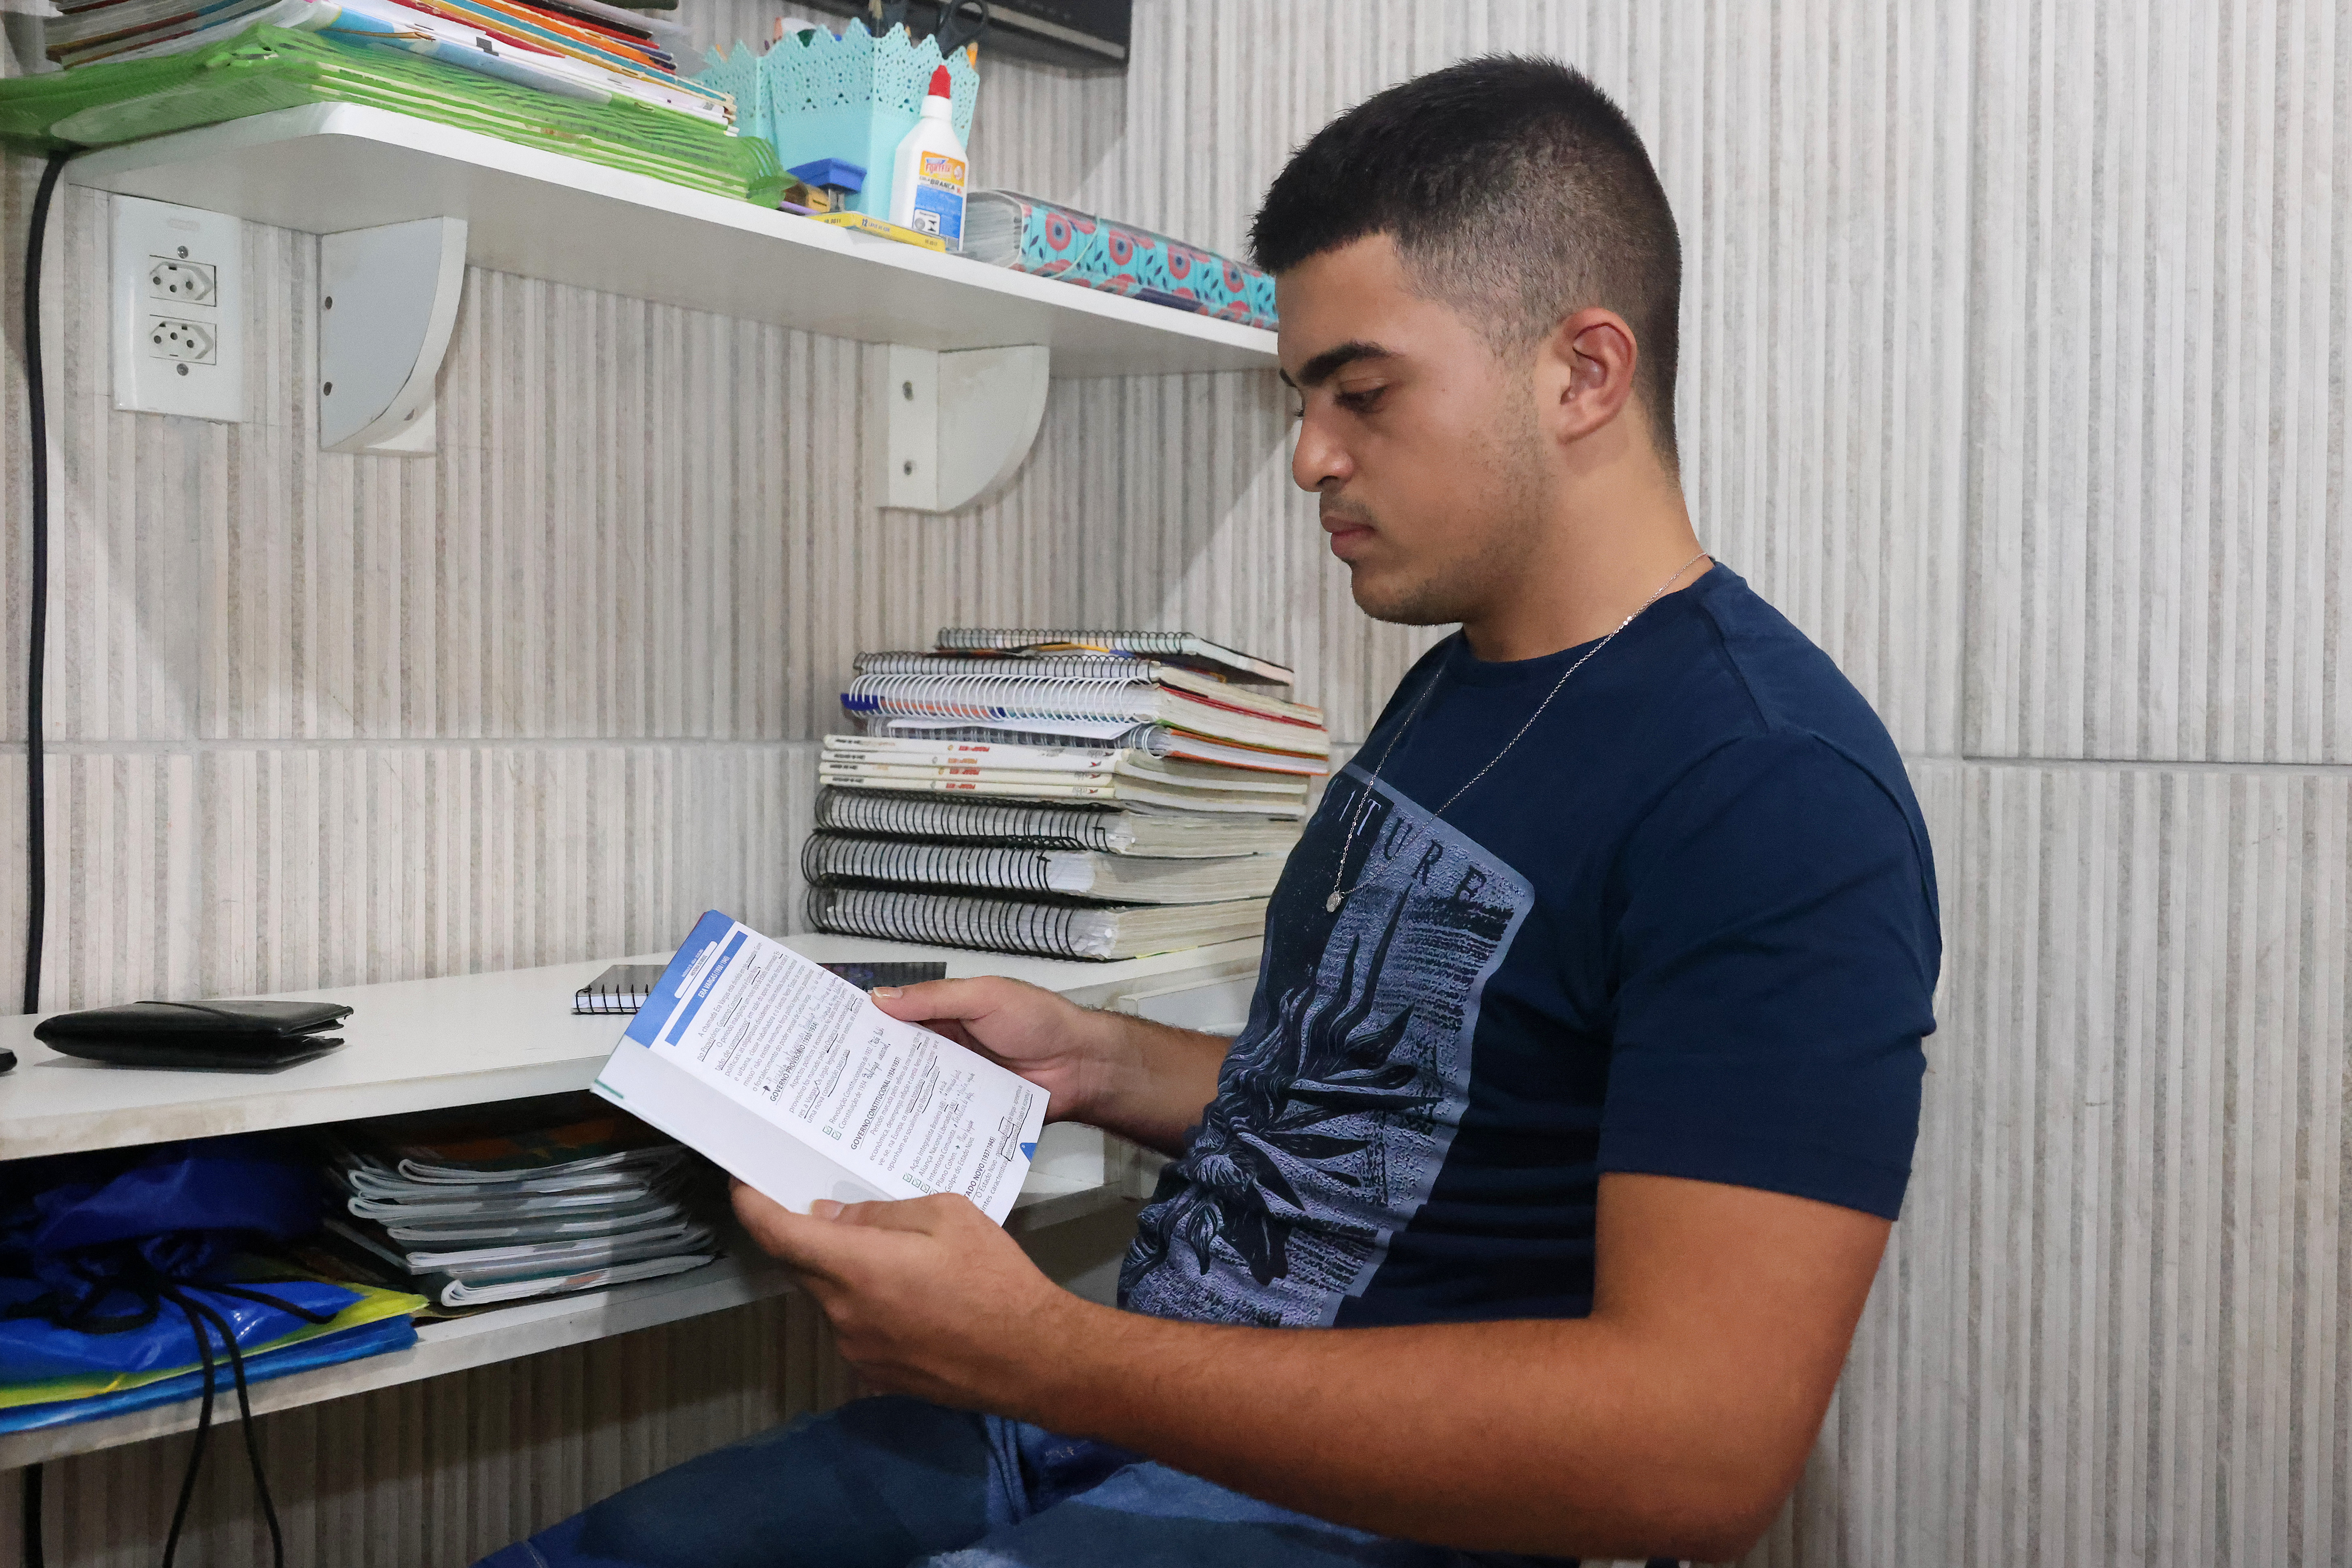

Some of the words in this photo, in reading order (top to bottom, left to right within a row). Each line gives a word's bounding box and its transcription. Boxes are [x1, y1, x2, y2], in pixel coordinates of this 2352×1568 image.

[698, 988, 708, 998] ERA
[703, 973, 717, 989] VARGAS
[713, 965, 723, 975] (1930
[720, 955, 730, 964] 1945)
[716, 1009, 731, 1027] Governo
[728, 984, 746, 1009] Constitucional
[744, 973, 754, 983] Estado
[748, 989, 756, 998] novo
[751, 981, 760, 990] tipo
[702, 1012, 717, 1032] chamada
[718, 991, 730, 1004] Vargas
[714, 1058, 725, 1071] tado
[751, 1001, 760, 1011] razão
[761, 987, 769, 997] apoio
[731, 1004, 746, 1025] inaugurou
[742, 1024, 758, 1047] oligarquias
[755, 1004, 771, 1025] dissidentes,
[768, 993, 777, 1004] classes
[737, 1057, 752, 1076] urbana,
[749, 1042, 760, 1055] classe
[757, 1016, 775, 1042] trabalhadora
[754, 1058, 762, 1069] não
[760, 1044, 771, 1058] existia
[768, 1024, 782, 1044] nenhuma
[778, 1014, 788, 1024] força
[754, 1051, 778, 1086] fortalecimento
[779, 1032, 788, 1046] poder
[786, 1018, 797, 1033] pessoal
[796, 1003, 806, 1014] Getúlio
[770, 1073, 789, 1101] GOVERNO
[801, 1021, 819, 1045] (1930/1934)
[819, 1065, 829, 1078] órgão
[825, 1044, 841, 1065] legislativos
[836, 1033, 846, 1044] foram
[789, 1086, 806, 1113] provisório
[807, 1060, 820, 1079] marcado
[824, 1029, 838, 1046] Orgânica,
[789, 1067, 805, 1089] Aspectos
[807, 1110, 817, 1123] uma
[814, 1096, 824, 1110] nova
[822, 1069, 838, 1096] constituição
[829, 1097, 847, 1124] Revolução
[843, 1061, 865, 1097] Constitucionalista
[864, 1046, 873, 1056] 1932.
[838, 1098, 858, 1129] Constituição
[858, 1080, 867, 1091] 1934.
[850, 1119, 870, 1149] GOVERNO
[867, 1080, 890, 1119] CONSTITUCIONAL
[886, 1056, 901, 1080] (1934/1937)
[869, 1129, 889, 1161] econômica,
[886, 1100, 903, 1128] desemprego,
[899, 1084, 910, 1099] inflação
[870, 1115, 884, 1135] Período
[881, 1096, 893, 1115] marcada
[891, 1085, 899, 1097] pelos
[896, 1070, 905, 1085] reflexos
[878, 1149, 891, 1165] ve-se,
[891, 1122, 905, 1140] Europa,
[904, 1098, 916, 1115] regimes
[911, 1078, 923, 1098] totalitários
[921, 1064, 931, 1078] (nazismo
[887, 1142, 905, 1171] opunham
[905, 1112, 919, 1135] socialismo
[920, 1083, 932, 1104] liberalismo
[1016, 1110, 1025, 1122] Estado
[910, 1156, 921, 1171] Ação
[917, 1129, 934, 1156] Integralista
[929, 1110, 942, 1129] Brasileira
[918, 1155, 933, 1176] Aliança
[929, 1133, 942, 1155] Nacional
[939, 1111, 952, 1134] Libertadora
[927, 1154, 944, 1182] Intentona
[941, 1129, 956, 1154] Comunista.
[973, 1163, 984, 1180] NOVO
[980, 1136, 996, 1163] (1937/1945)
[978, 1173, 992, 1191] Estado
[987, 1160, 997, 1173] Novo
[1008, 1106, 1016, 1116] Vargas
[935, 1170, 948, 1187] Plano
[944, 1152, 957, 1170] Cohen.
[945, 1174, 958, 1194] Golpe
[957, 1149, 969, 1166] Estado
